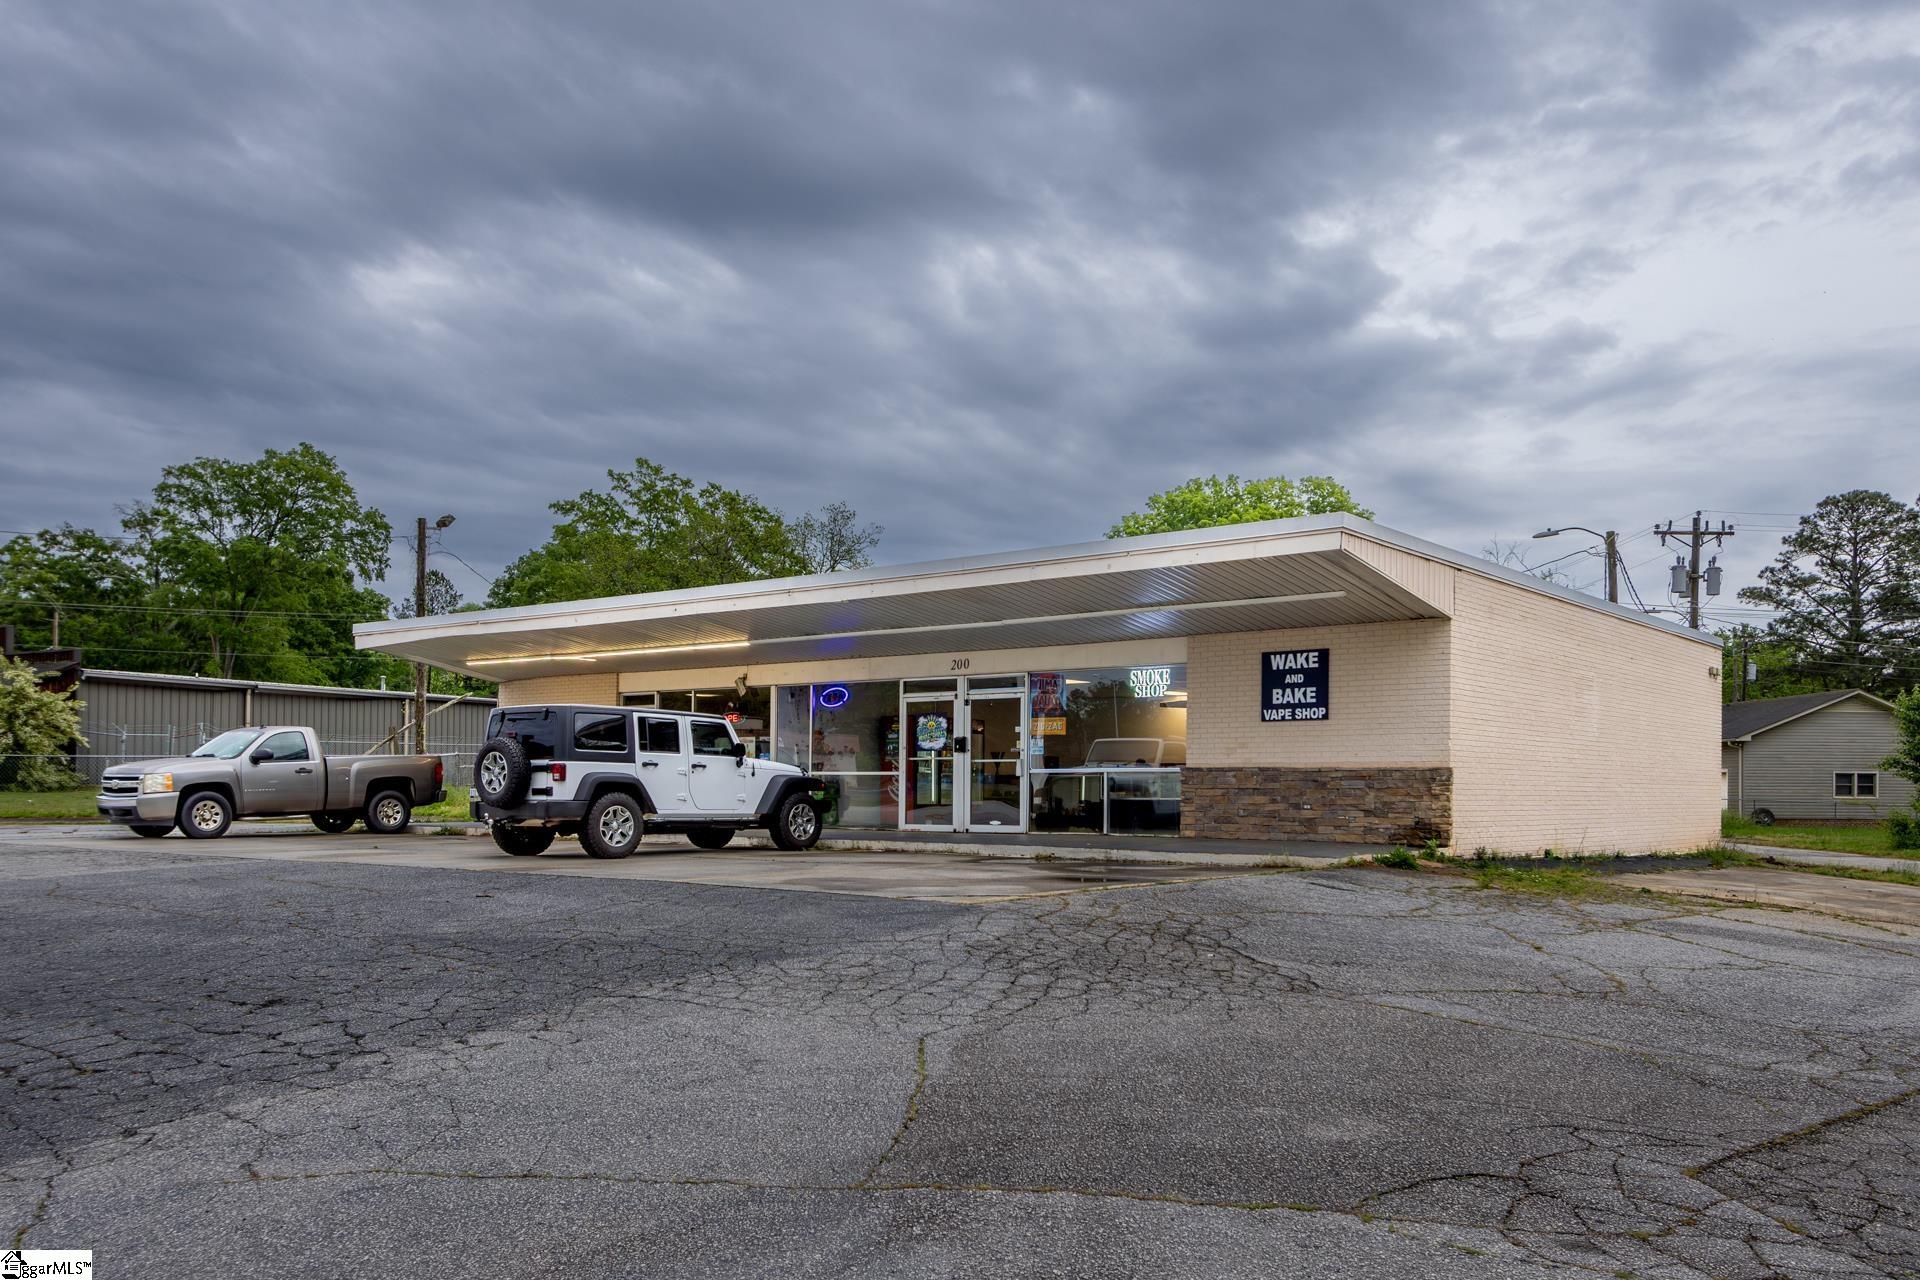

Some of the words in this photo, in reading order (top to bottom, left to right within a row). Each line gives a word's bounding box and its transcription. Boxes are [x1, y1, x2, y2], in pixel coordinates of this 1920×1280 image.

[951, 658, 970, 670] 200
[1270, 652, 1319, 670] WAKE
[1130, 669, 1170, 686] SMOKE
[1285, 674, 1304, 683] AND
[1135, 684, 1168, 697] SHOP
[1272, 687, 1317, 704] BAKE
[1263, 709, 1292, 720] VAPE
[1295, 707, 1326, 719] SHOP
